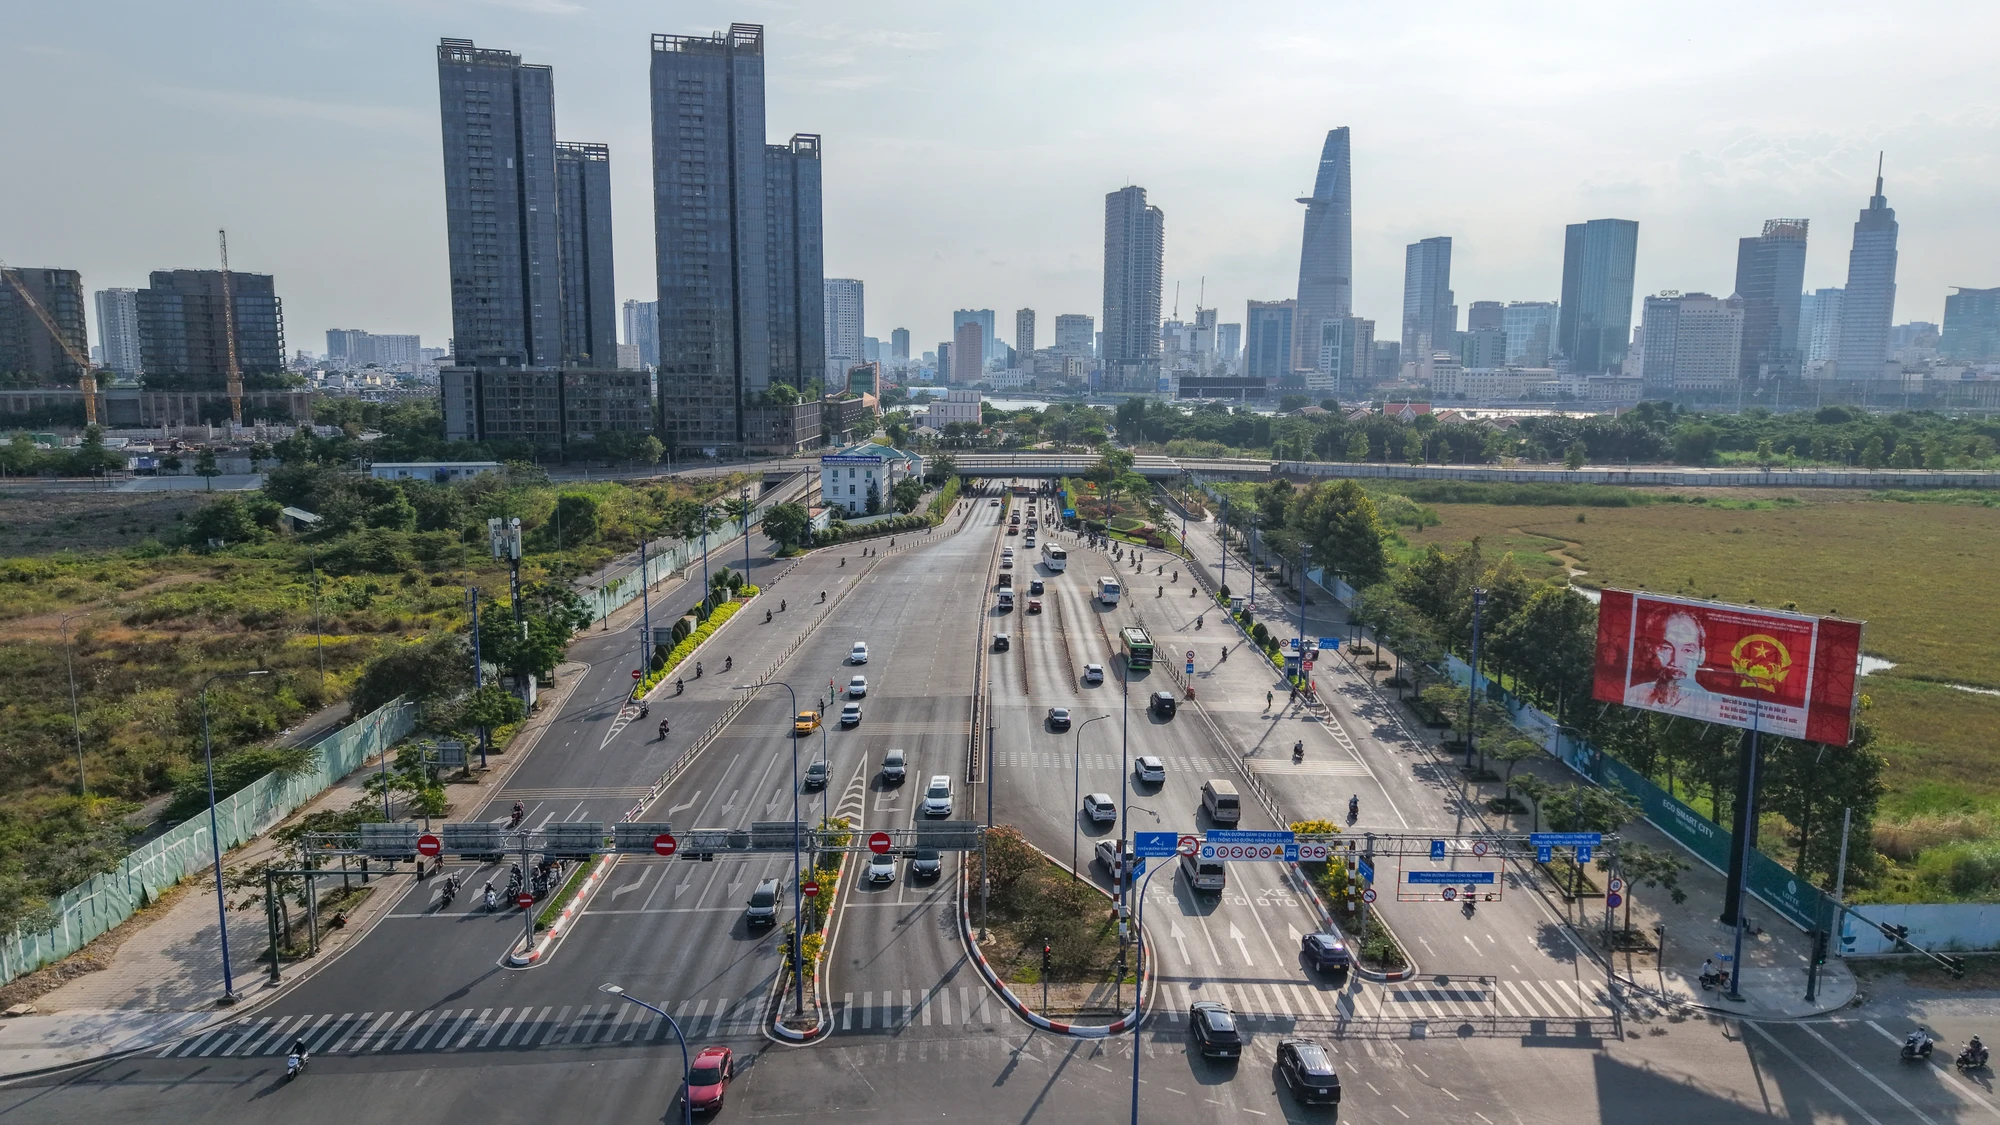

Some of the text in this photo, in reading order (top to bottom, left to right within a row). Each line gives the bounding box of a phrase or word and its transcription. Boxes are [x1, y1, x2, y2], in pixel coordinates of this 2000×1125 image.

[1663, 799, 1675, 812] ECO
[1676, 808, 1697, 827] SMART
[1698, 823, 1714, 838] CITY
[1260, 888, 1290, 896] XE
[1256, 896, 1299, 906] ÔTÔ
[1783, 891, 1799, 906] LOTTE
